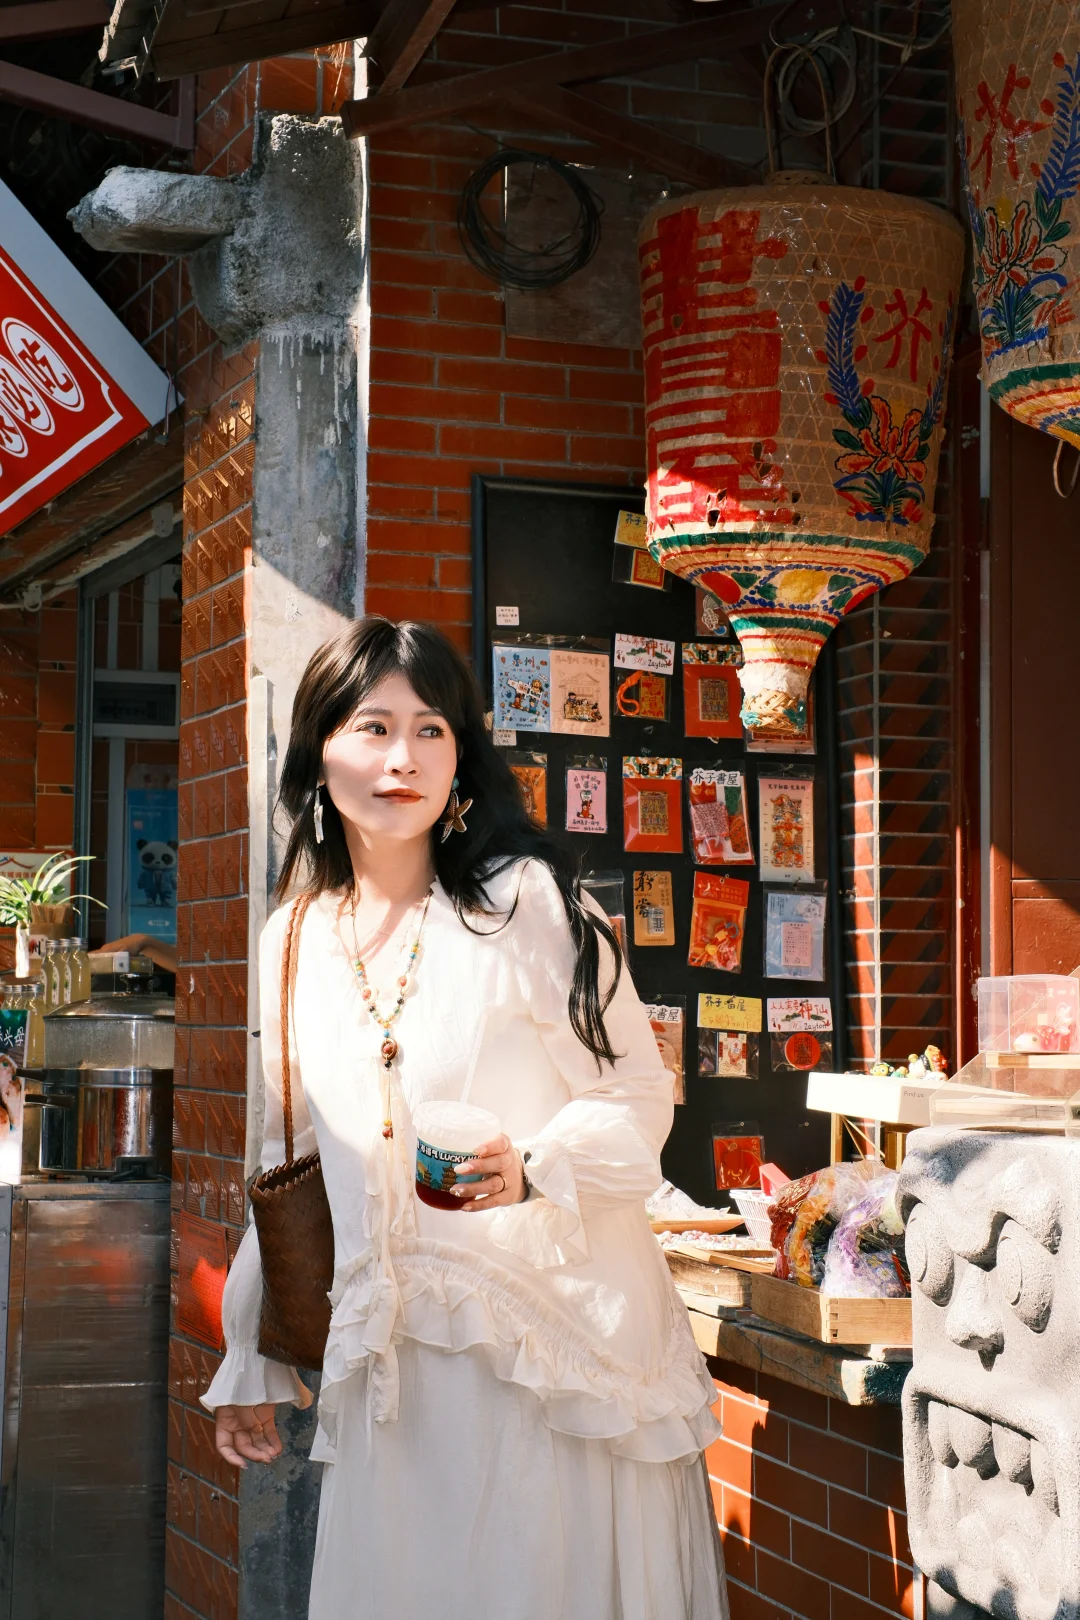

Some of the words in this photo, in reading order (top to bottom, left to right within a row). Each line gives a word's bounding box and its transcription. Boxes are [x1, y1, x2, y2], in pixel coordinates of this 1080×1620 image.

[692, 770, 739, 786] 芥子書屋
[804, 1022, 827, 1032] Zayton
[439, 1152, 467, 1163] LUCKY
